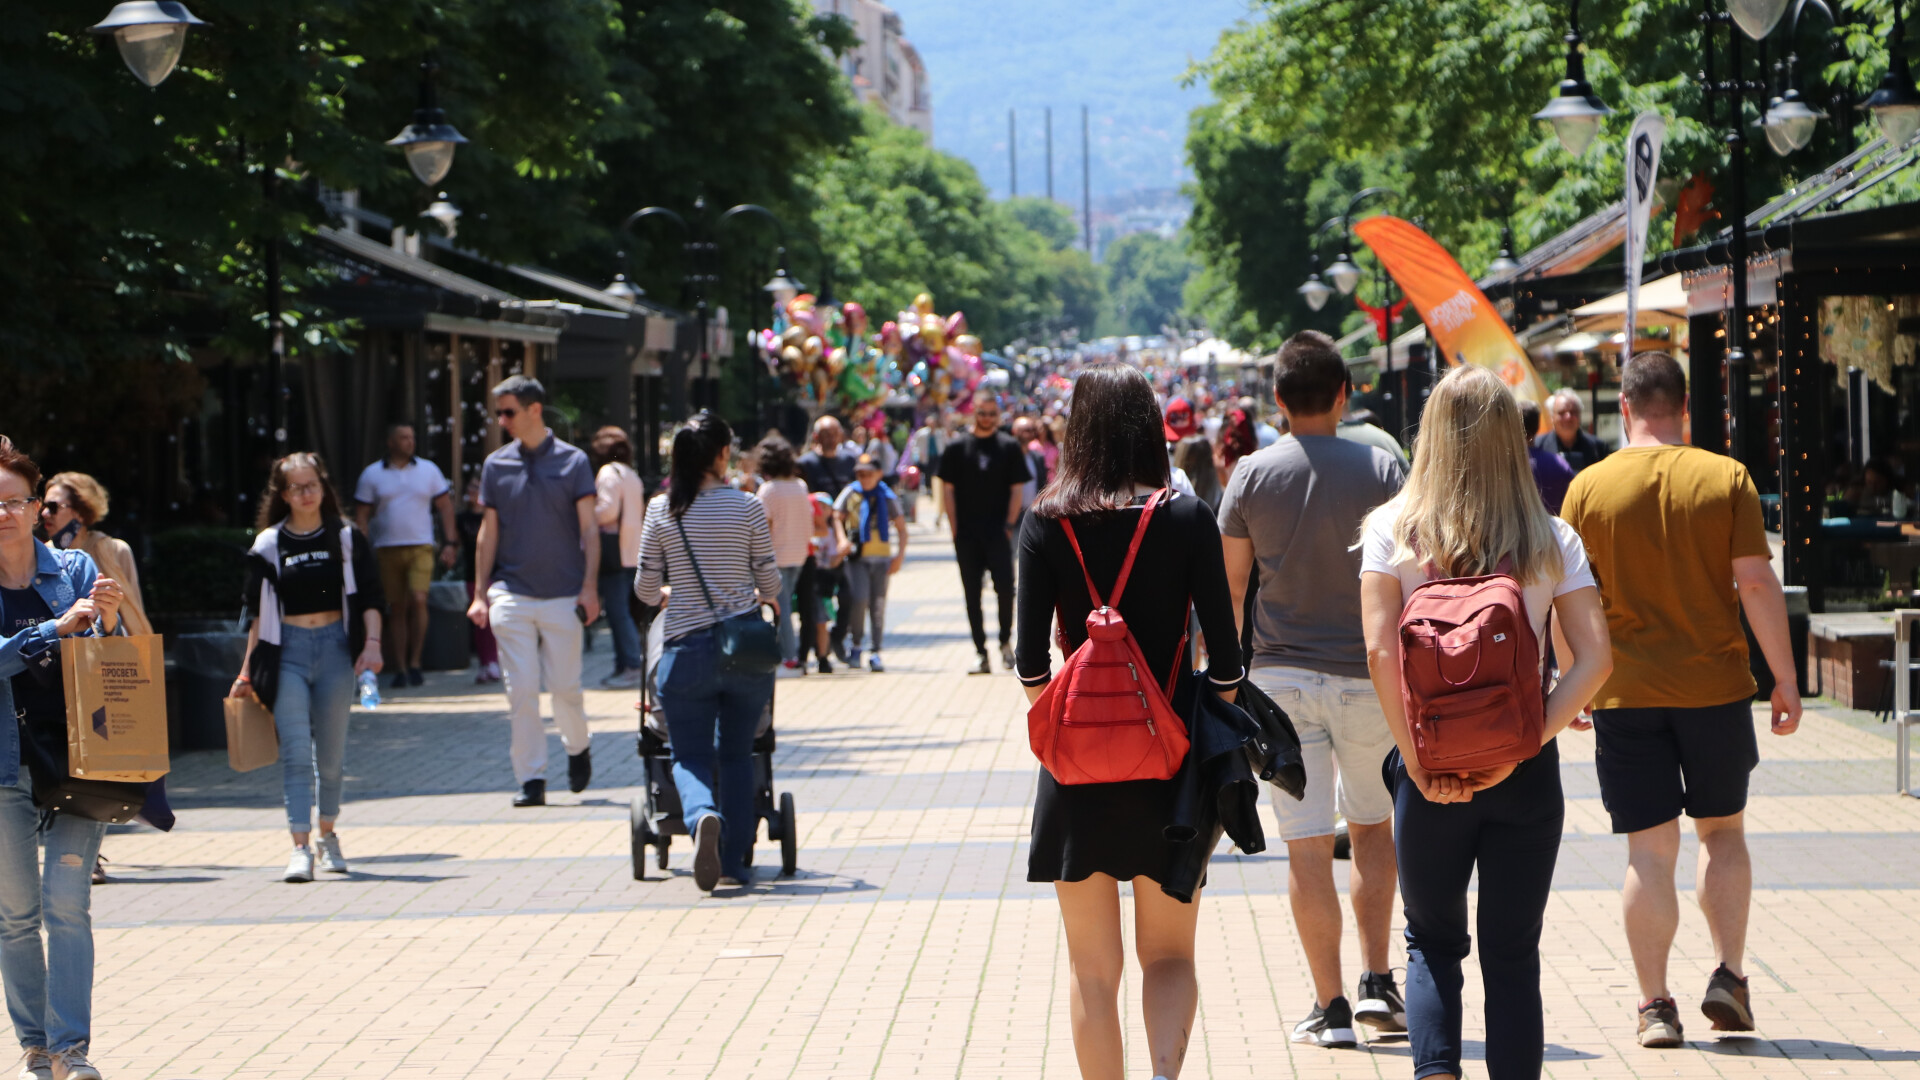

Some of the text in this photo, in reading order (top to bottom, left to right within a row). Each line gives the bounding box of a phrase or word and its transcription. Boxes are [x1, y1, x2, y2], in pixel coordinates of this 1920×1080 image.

[310, 551, 329, 560] YOR
[15, 616, 46, 627] PARIS
[102, 668, 138, 677] ПРОСВЕТА
